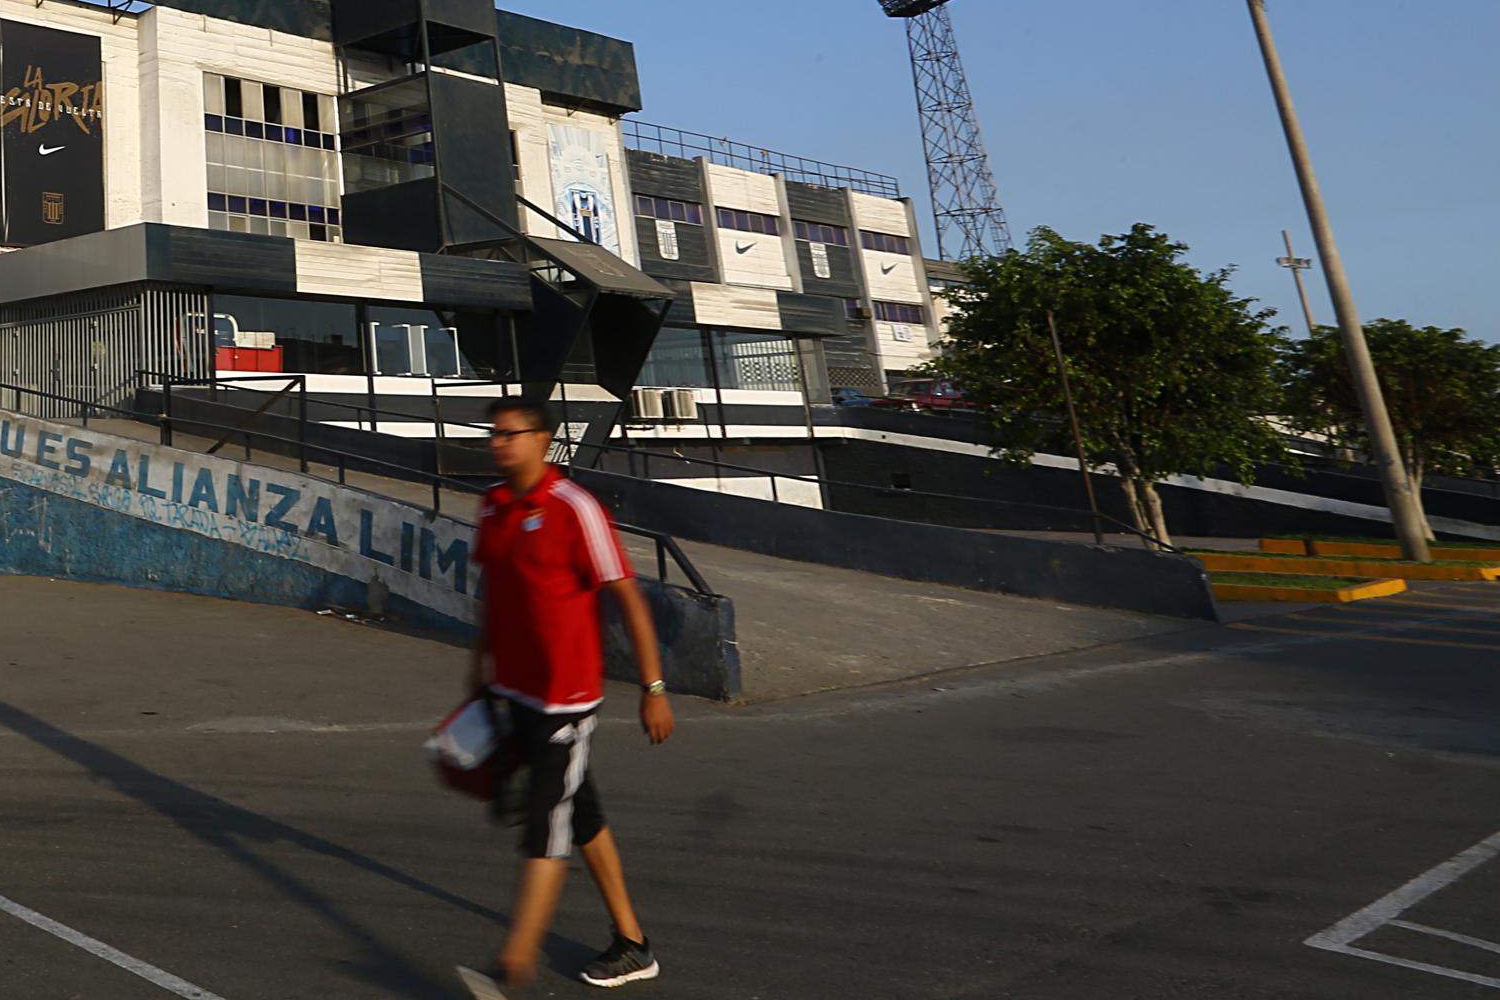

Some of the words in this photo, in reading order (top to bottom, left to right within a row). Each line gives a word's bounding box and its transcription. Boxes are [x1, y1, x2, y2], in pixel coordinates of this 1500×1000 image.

[24, 64, 43, 91] LA
[38, 101, 51, 111] DE
[36, 430, 93, 478] ES
[104, 448, 339, 547] ALIANZA
[359, 508, 484, 600] LIM
